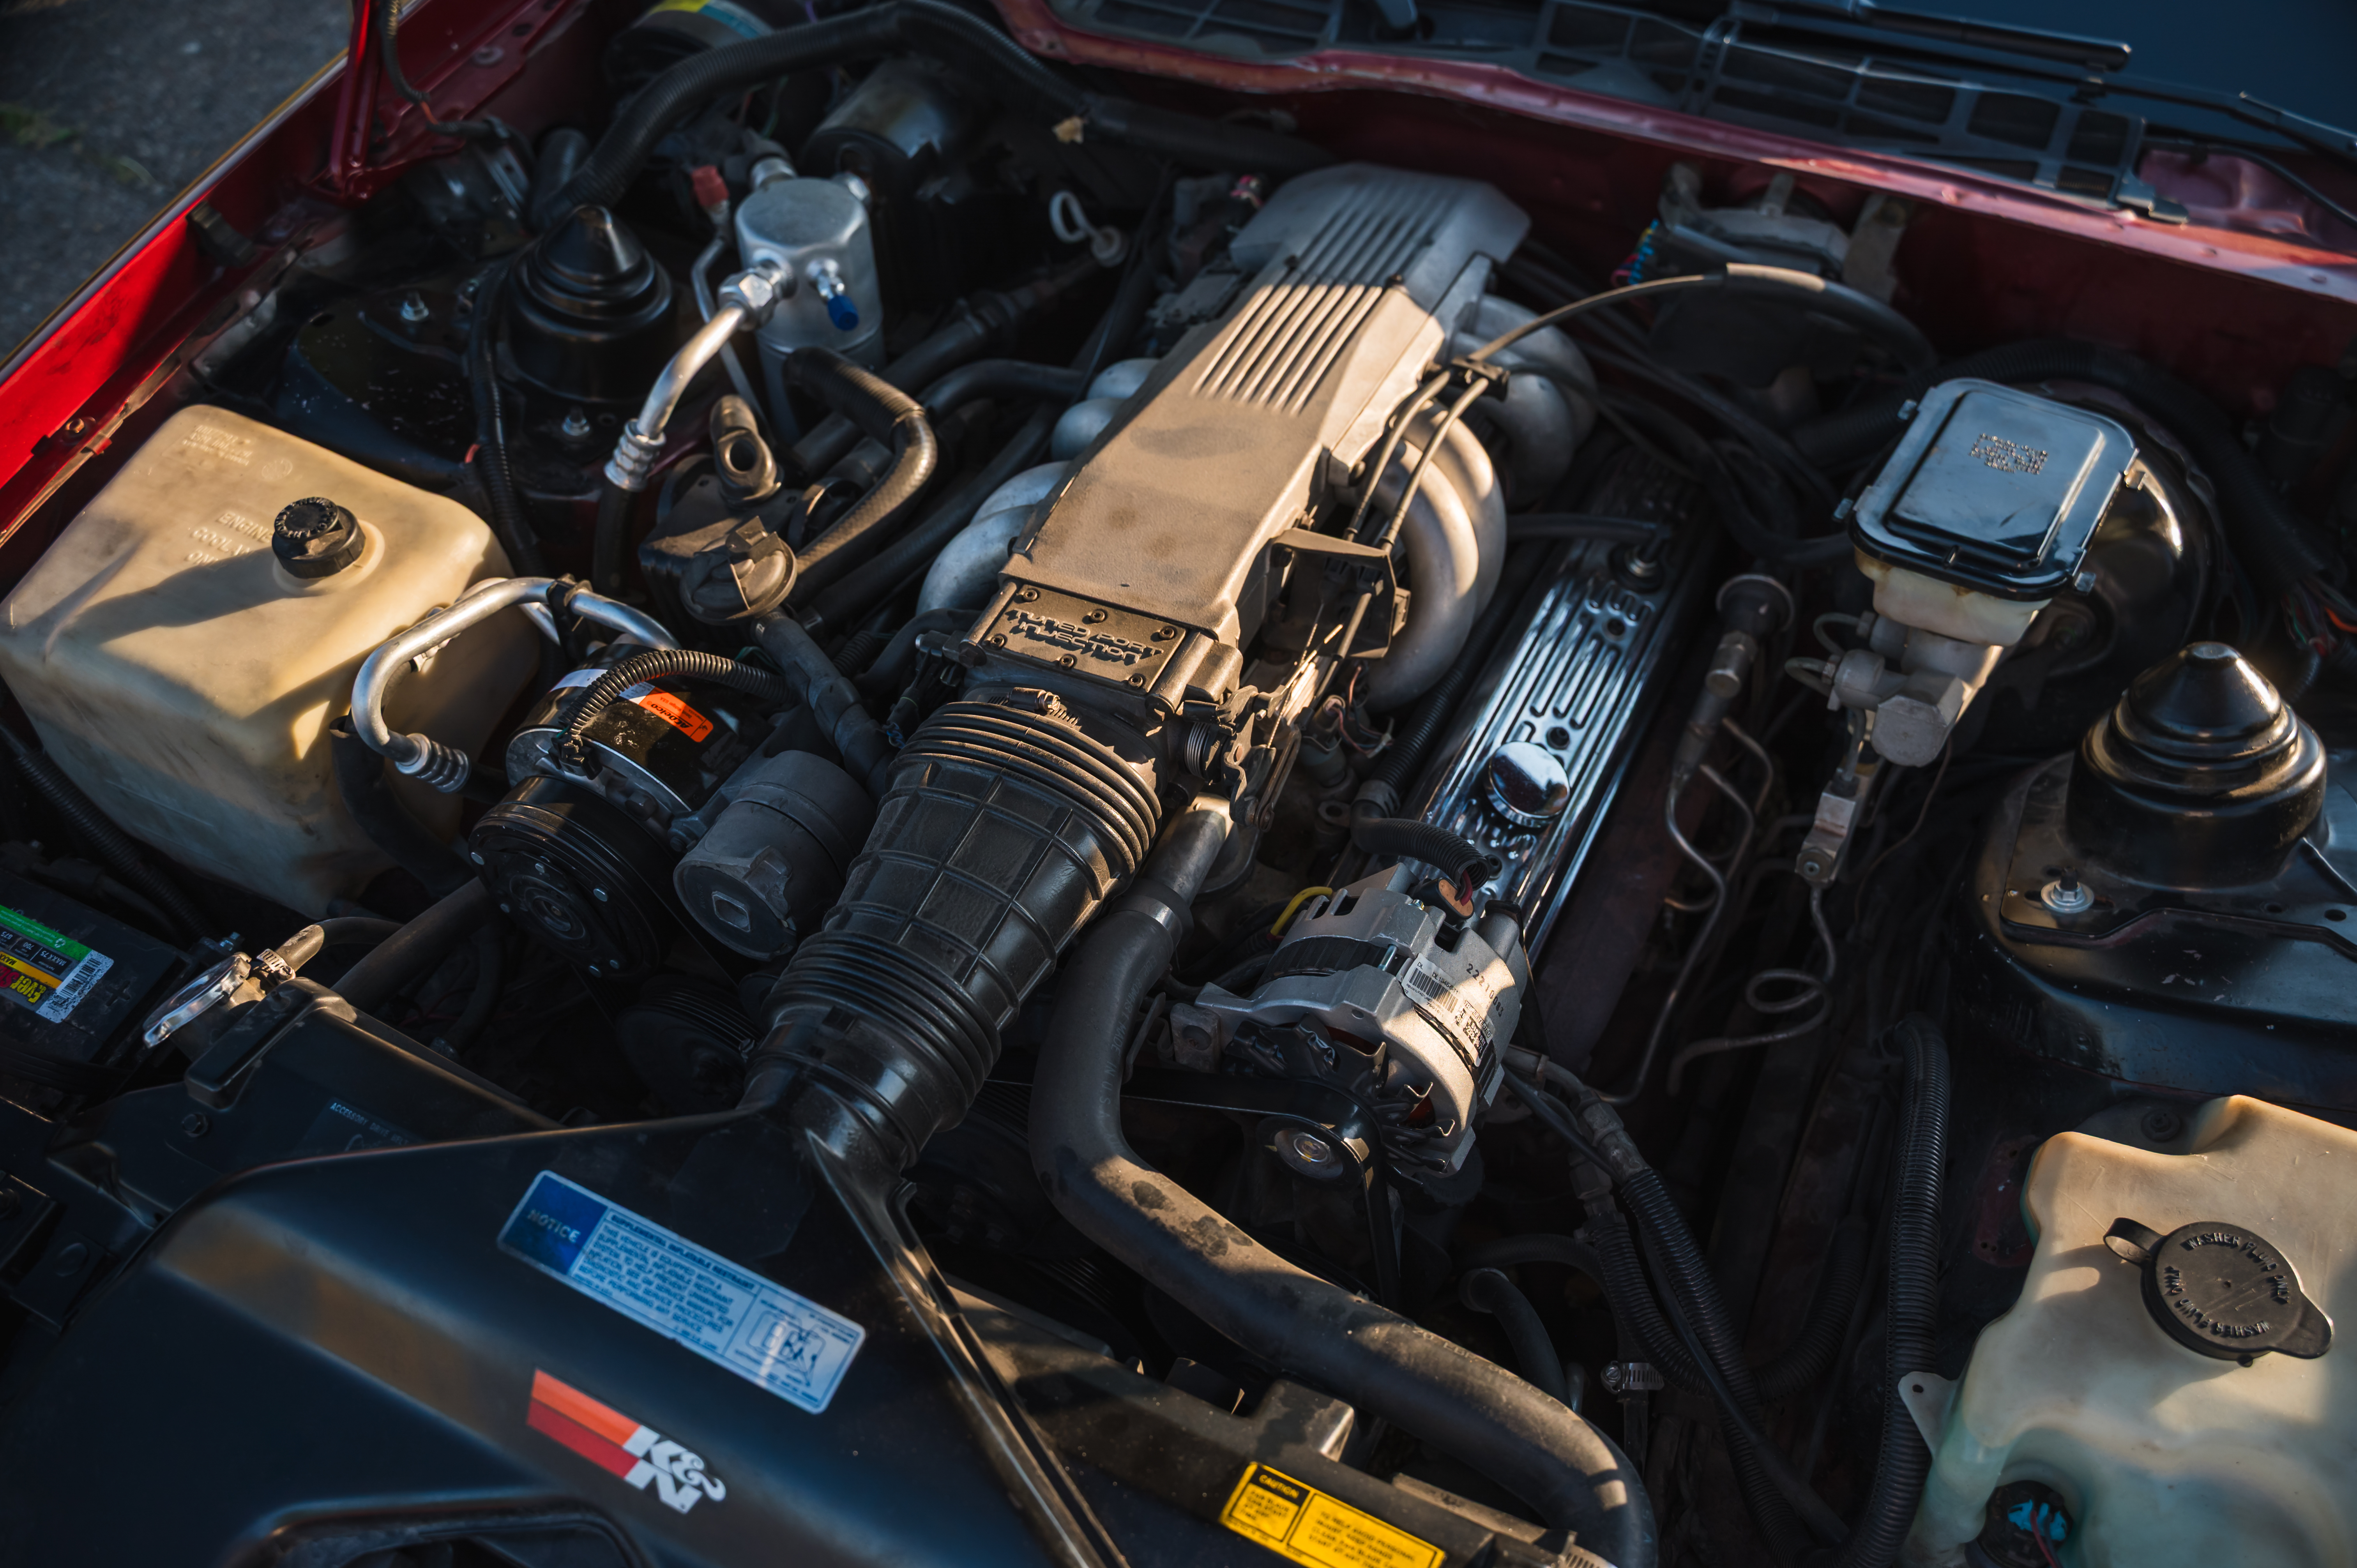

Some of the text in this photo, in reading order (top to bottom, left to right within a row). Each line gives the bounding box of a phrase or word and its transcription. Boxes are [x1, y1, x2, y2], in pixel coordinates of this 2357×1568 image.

[217, 511, 272, 544] ENGINE
[1013, 608, 1164, 657] TUNED PORT
[1018, 621, 1142, 664] INJECTION
[650, 703, 689, 728] ACDelco
[0, 931, 13, 939] 875
[23, 941, 34, 950] 700
[40, 949, 66, 966] MAXX 75
[1406, 983, 1432, 1002] REMANUFACTURED
[1464, 1000, 1492, 1038] TRIPLE TESTED
[1470, 1022, 1486, 1046] SUPPORT
[1110, 1021, 1127, 1058] MADE
[1104, 1061, 1117, 1076] IN
[330, 1102, 369, 1126] ACCESSORY
[369, 1122, 390, 1137] DRIVE
[528, 1209, 581, 1244] NOTICE
[593, 1240, 621, 1259] SYSTEM
[634, 1261, 654, 1276] HELP
[618, 1233, 650, 1254] VEHICLE
[658, 1253, 697, 1277] EQUIPPED
[2186, 1232, 2290, 1304] WASHER FLUID ONLY
[625, 1268, 641, 1280] SEE
[654, 1282, 685, 1303] SERVICE
[642, 1287, 673, 1307] SERVICE
[606, 1279, 655, 1308] PERFORMING
[671, 1312, 703, 1333] SERVICE
[2217, 1320, 2272, 1337] WASHER
[622, 1425, 726, 1514] K&N
[1258, 1473, 1300, 1499] CAUTION
[1330, 1515, 1352, 1530] HELP
[1350, 1526, 1375, 1542] AVOID
[1374, 1538, 1417, 1563] PERSONAL
